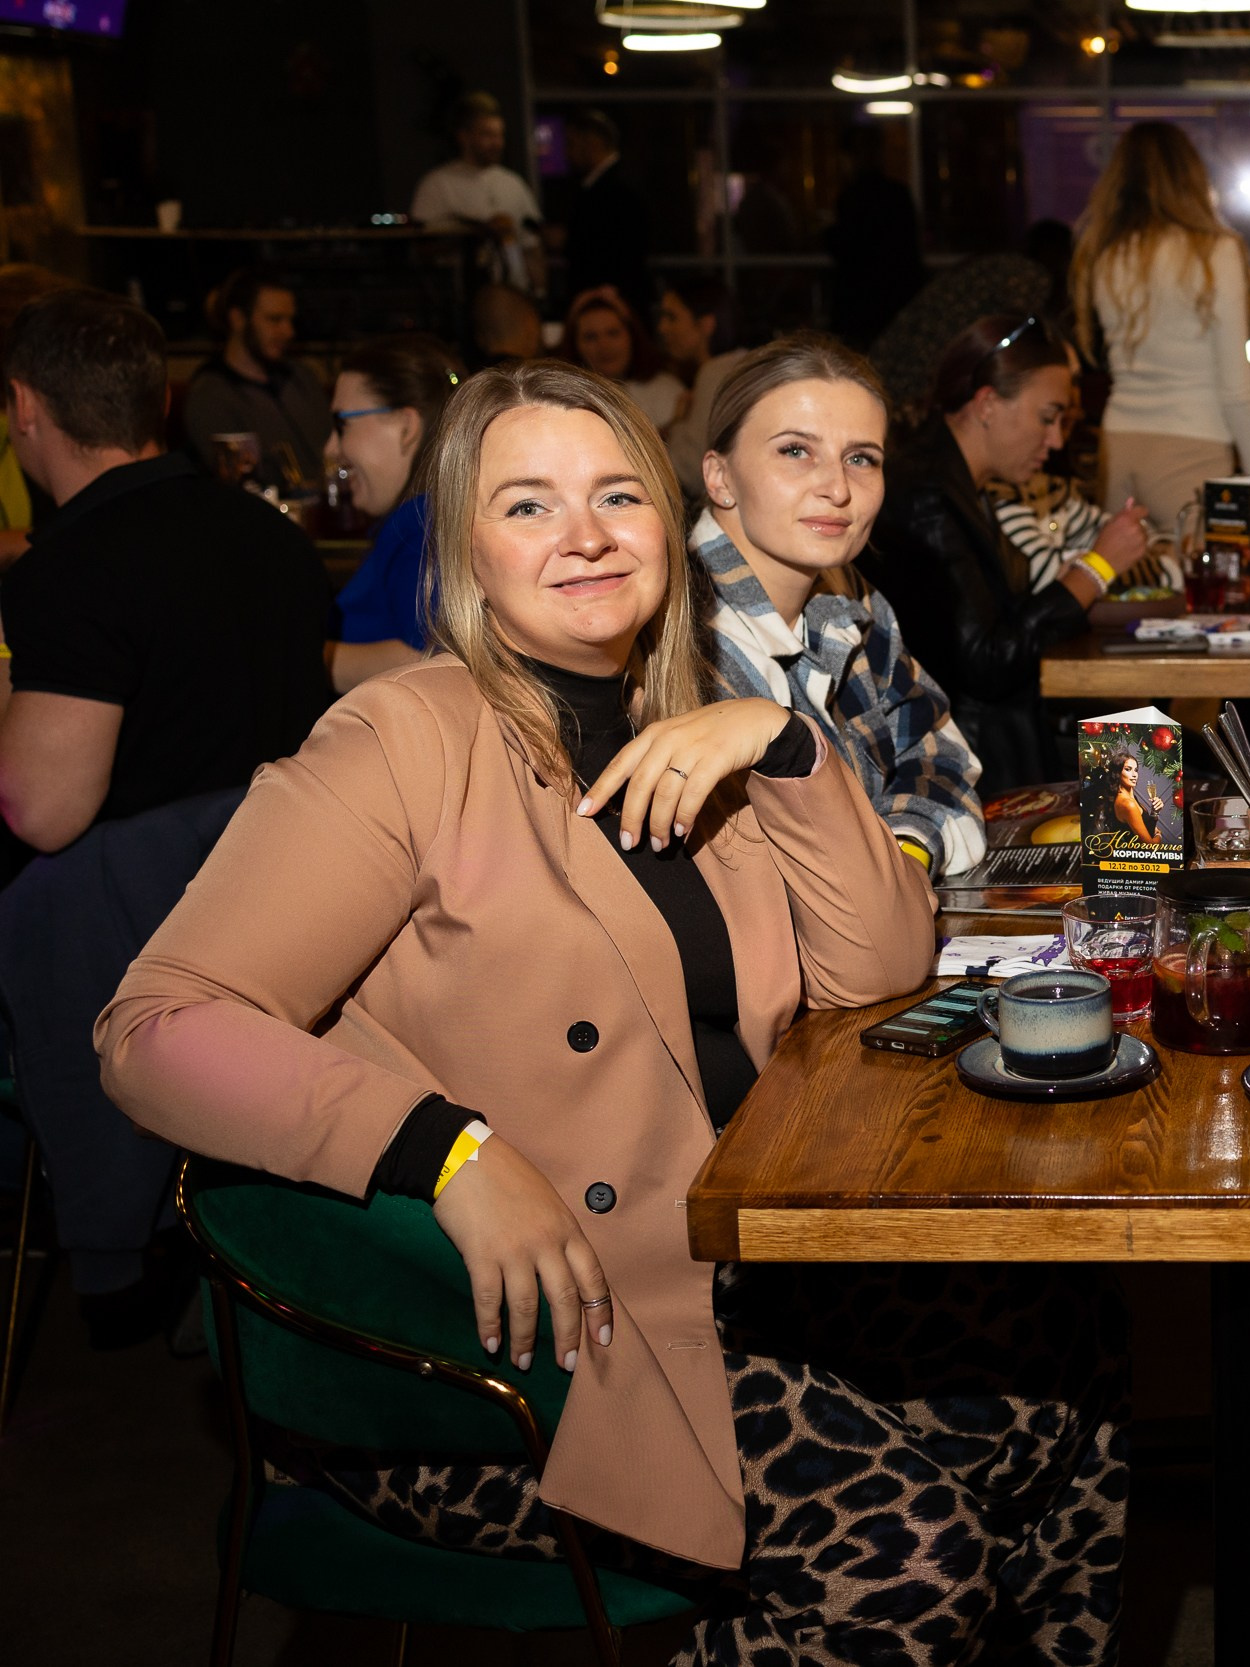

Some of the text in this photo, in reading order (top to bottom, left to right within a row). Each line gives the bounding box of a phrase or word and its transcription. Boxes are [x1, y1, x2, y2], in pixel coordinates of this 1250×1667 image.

[1085, 830, 1183, 858] Новогодние
[1113, 850, 1183, 860] КОРПОРАТИВЫ
[1108, 862, 1127, 870] 12.12
[1140, 864, 1160, 872] 30.12
